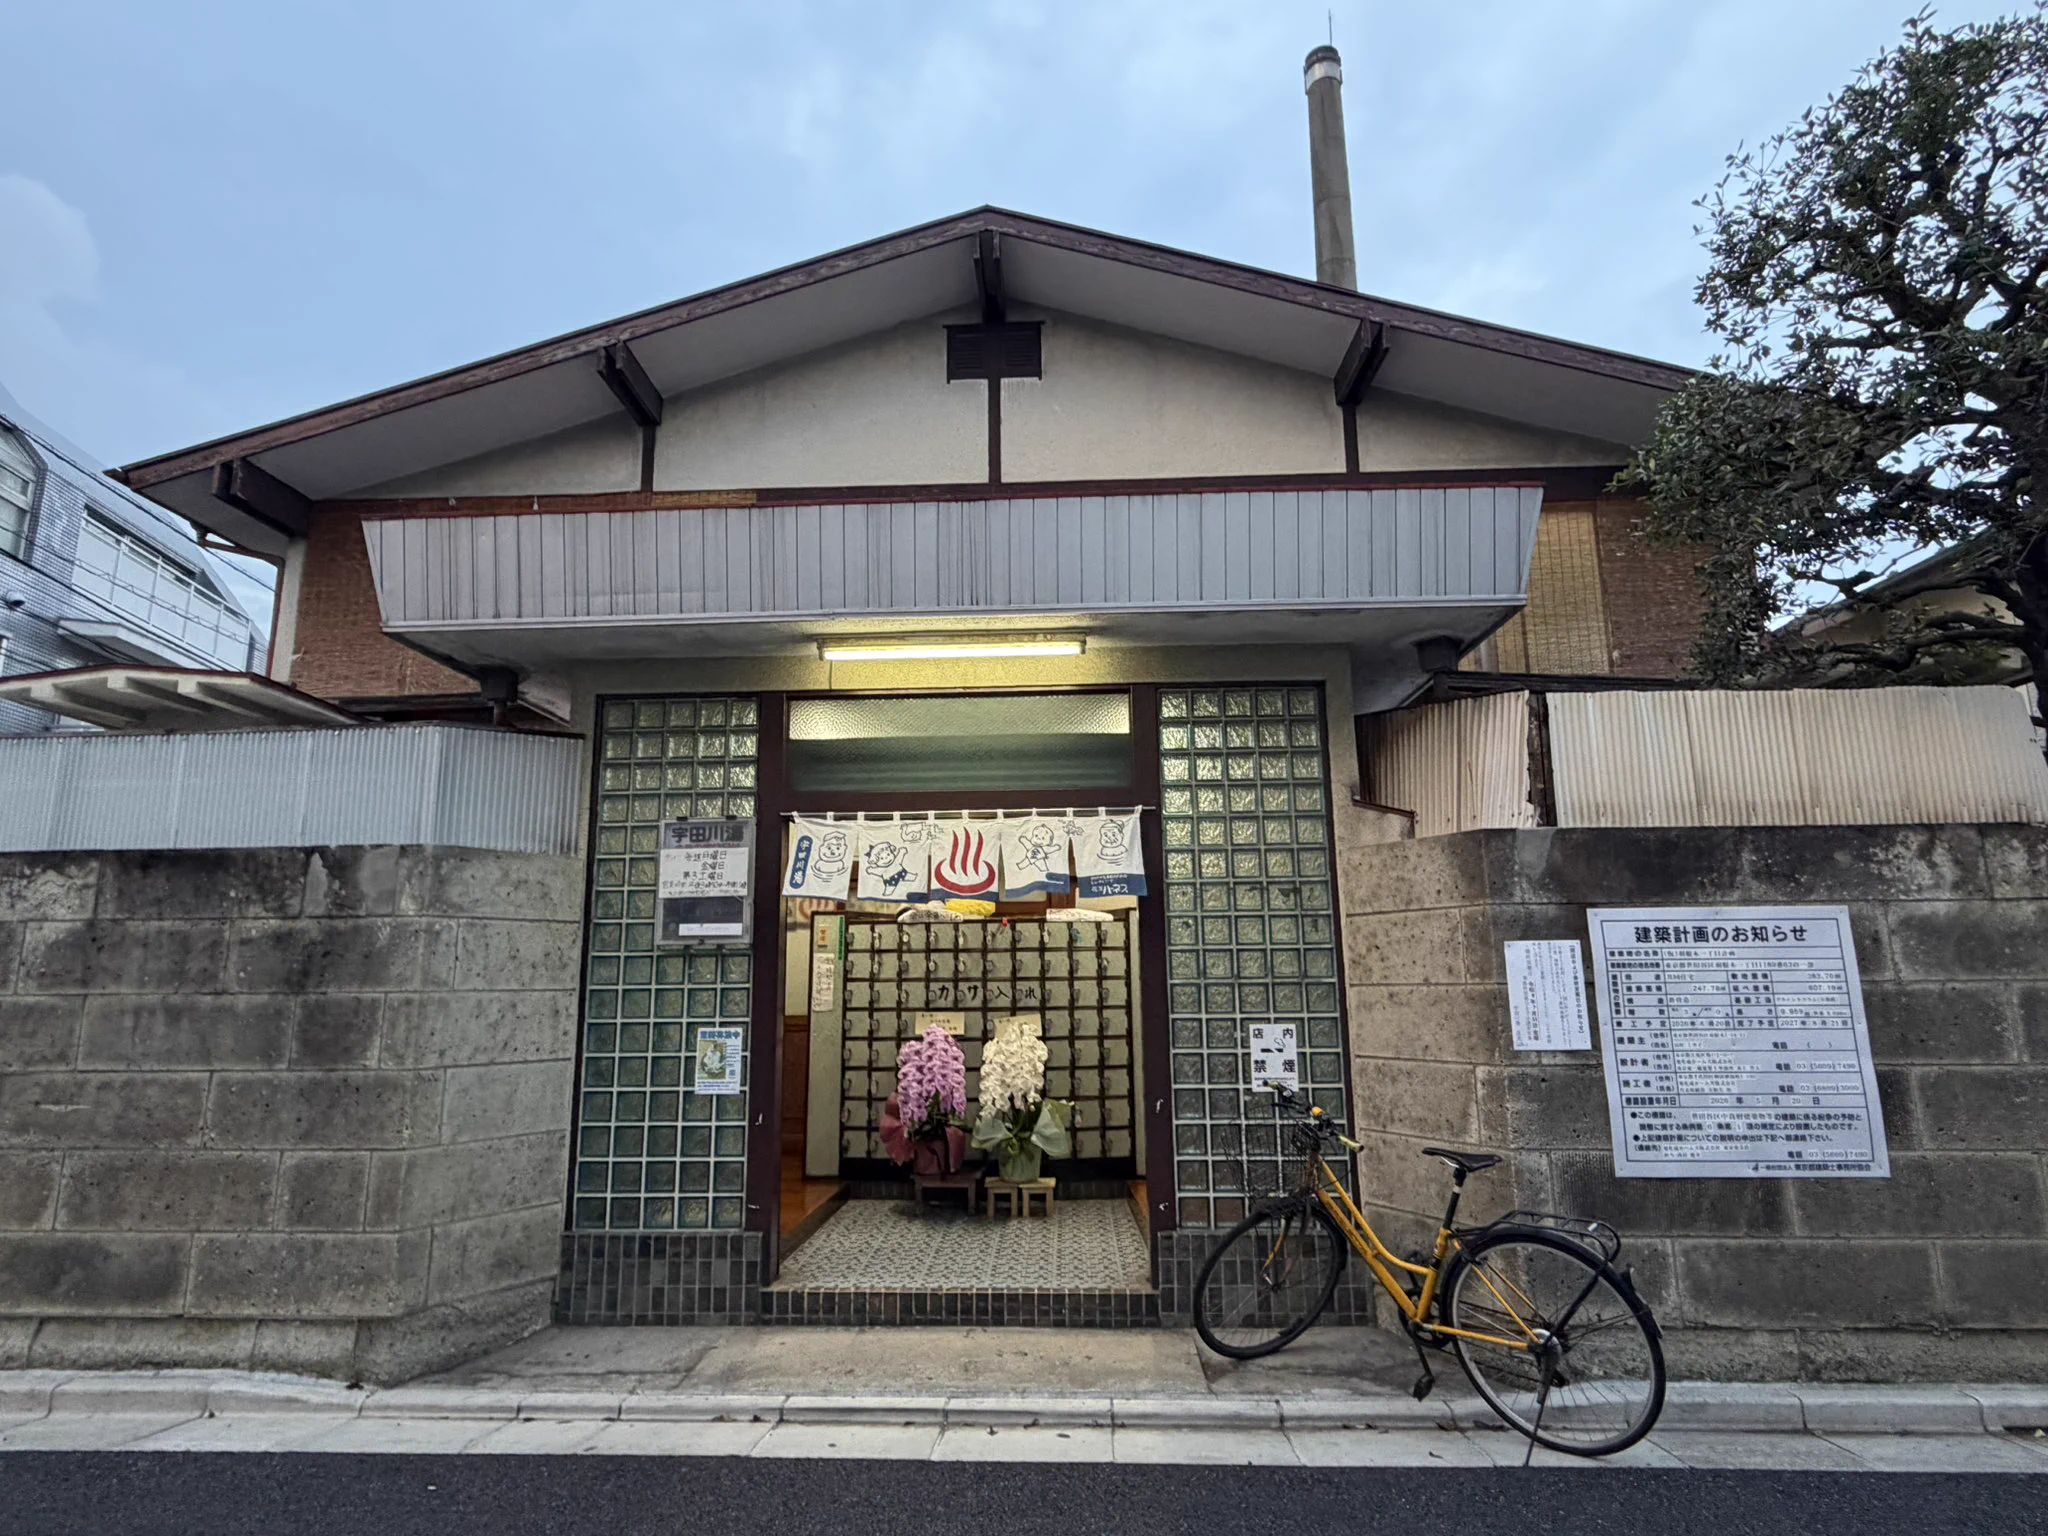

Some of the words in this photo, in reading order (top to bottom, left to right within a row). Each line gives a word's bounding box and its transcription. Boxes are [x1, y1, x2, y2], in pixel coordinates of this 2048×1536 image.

[672, 825, 744, 843] 宇田川湯
[792, 840, 810, 885] 宇田川湯
[1634, 925, 1807, 943] 建築計画のお知らせ
[1253, 1028, 1293, 1039] 店内
[1254, 1059, 1296, 1073] 禁煙
[1772, 1097, 1779, 1105] 月
[1812, 1097, 1820, 1105] 日
